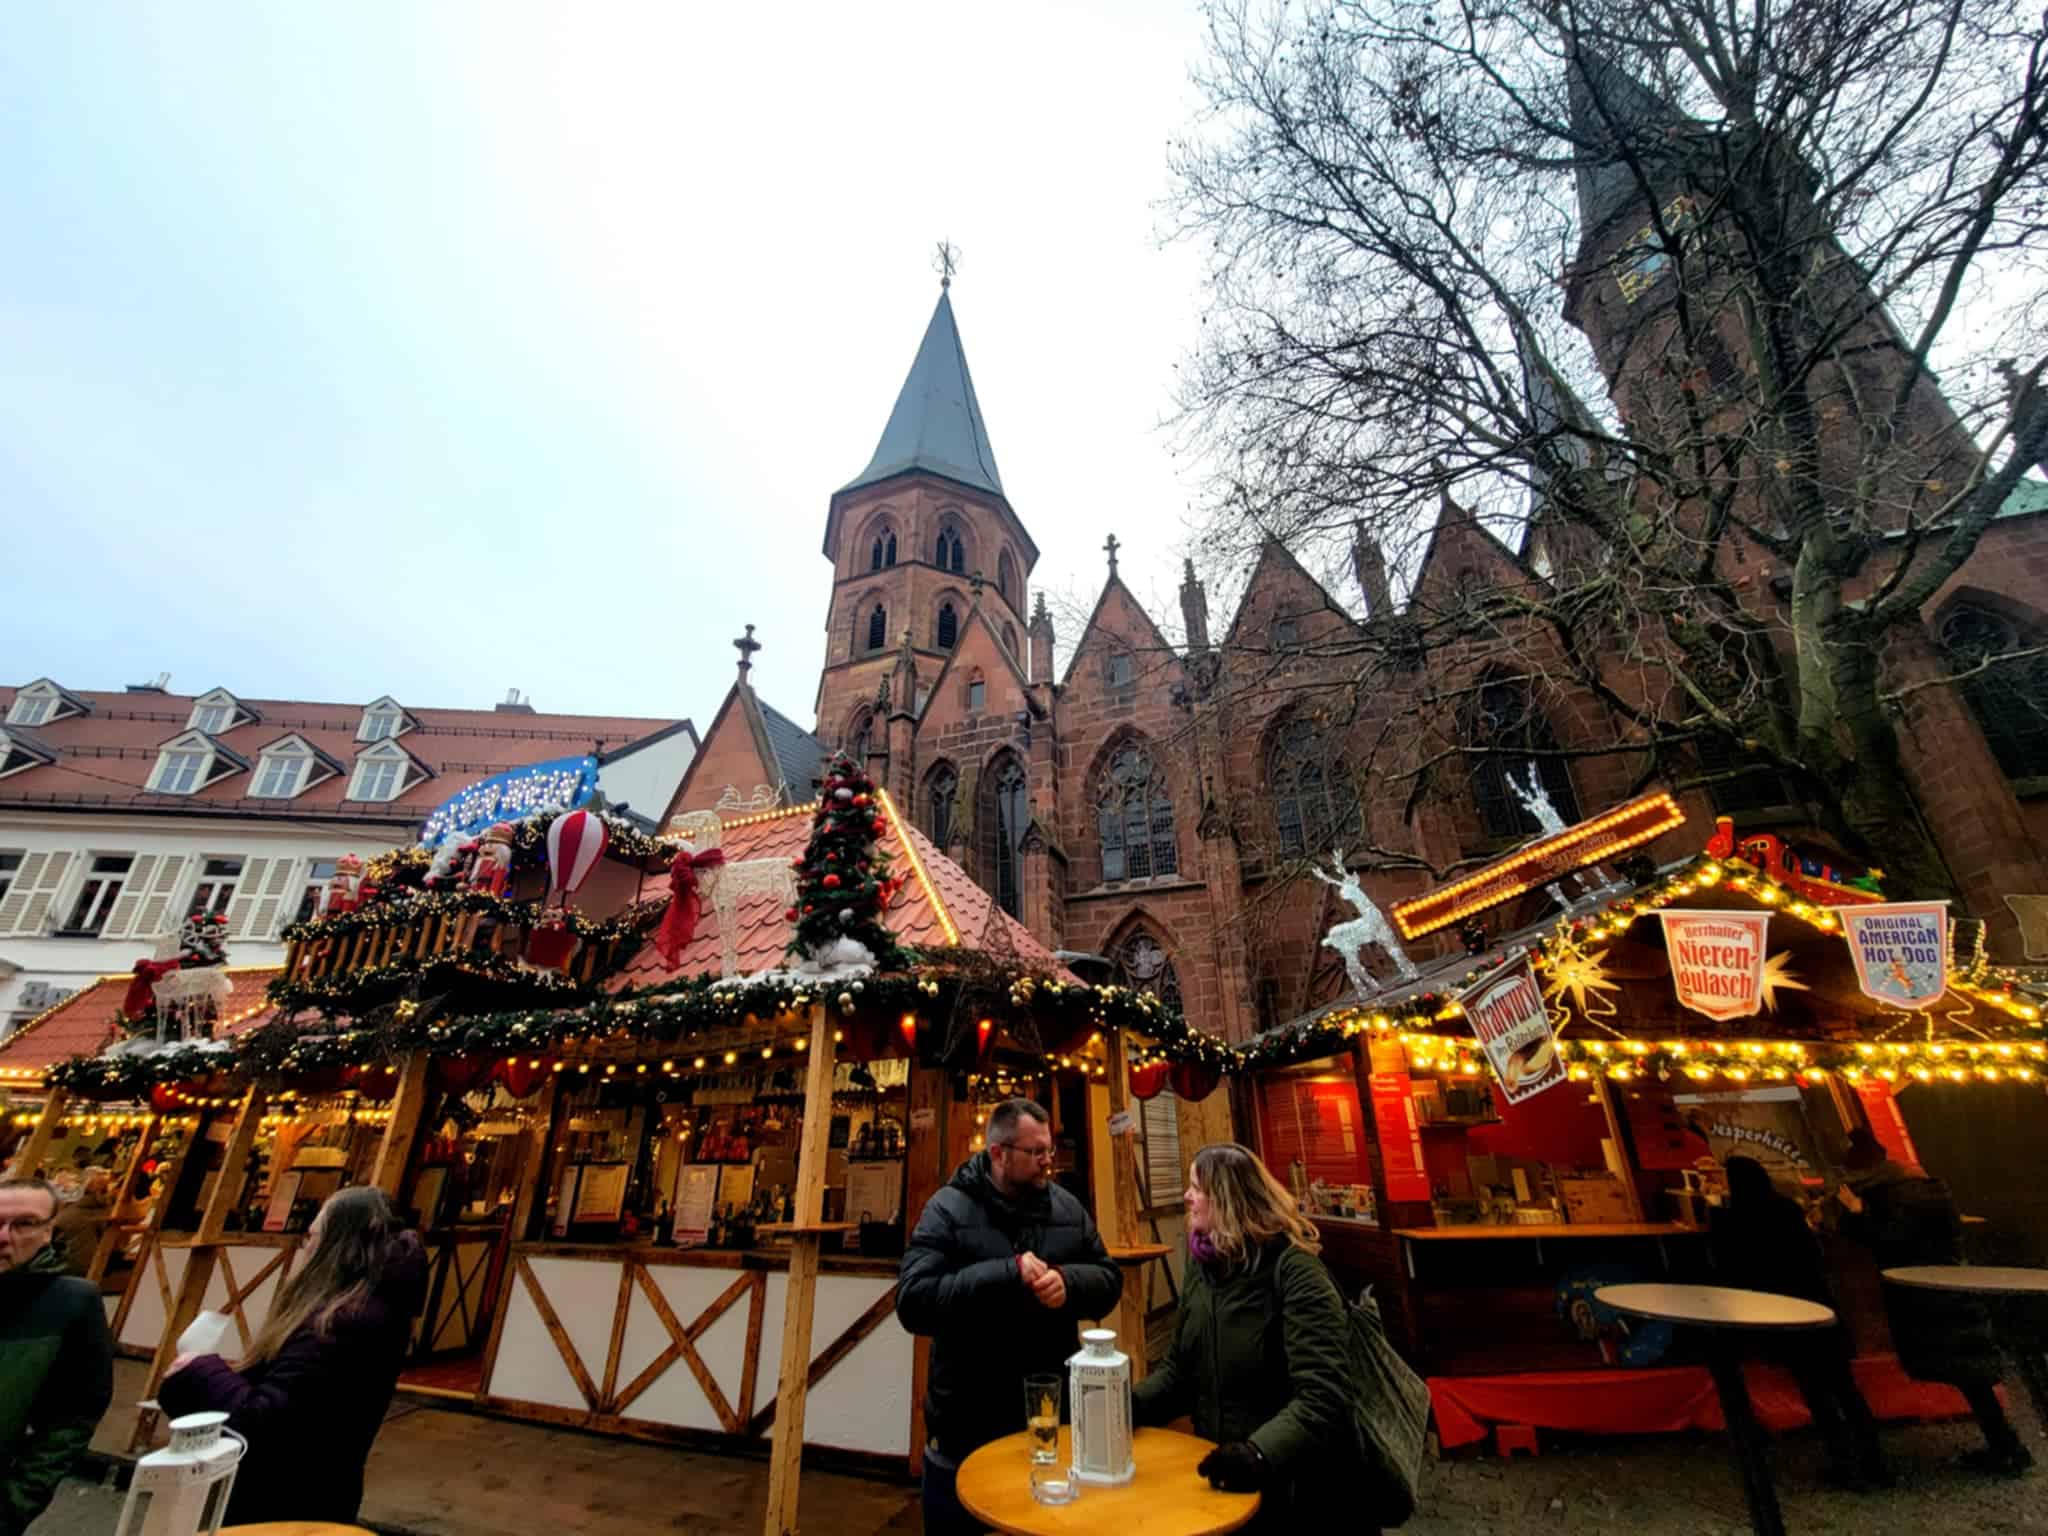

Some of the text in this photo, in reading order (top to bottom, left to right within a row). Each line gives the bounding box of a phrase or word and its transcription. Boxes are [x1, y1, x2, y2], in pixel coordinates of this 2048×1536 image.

[1864, 917, 1924, 931] ORIGINAL
[1858, 928, 1939, 946] AMERICAN
[1677, 939, 1759, 970] Nieren-
[1864, 946, 1937, 965] HOT DOG
[1680, 968, 1752, 999] gulasch
[1469, 974, 1543, 1046] Bratwurst
